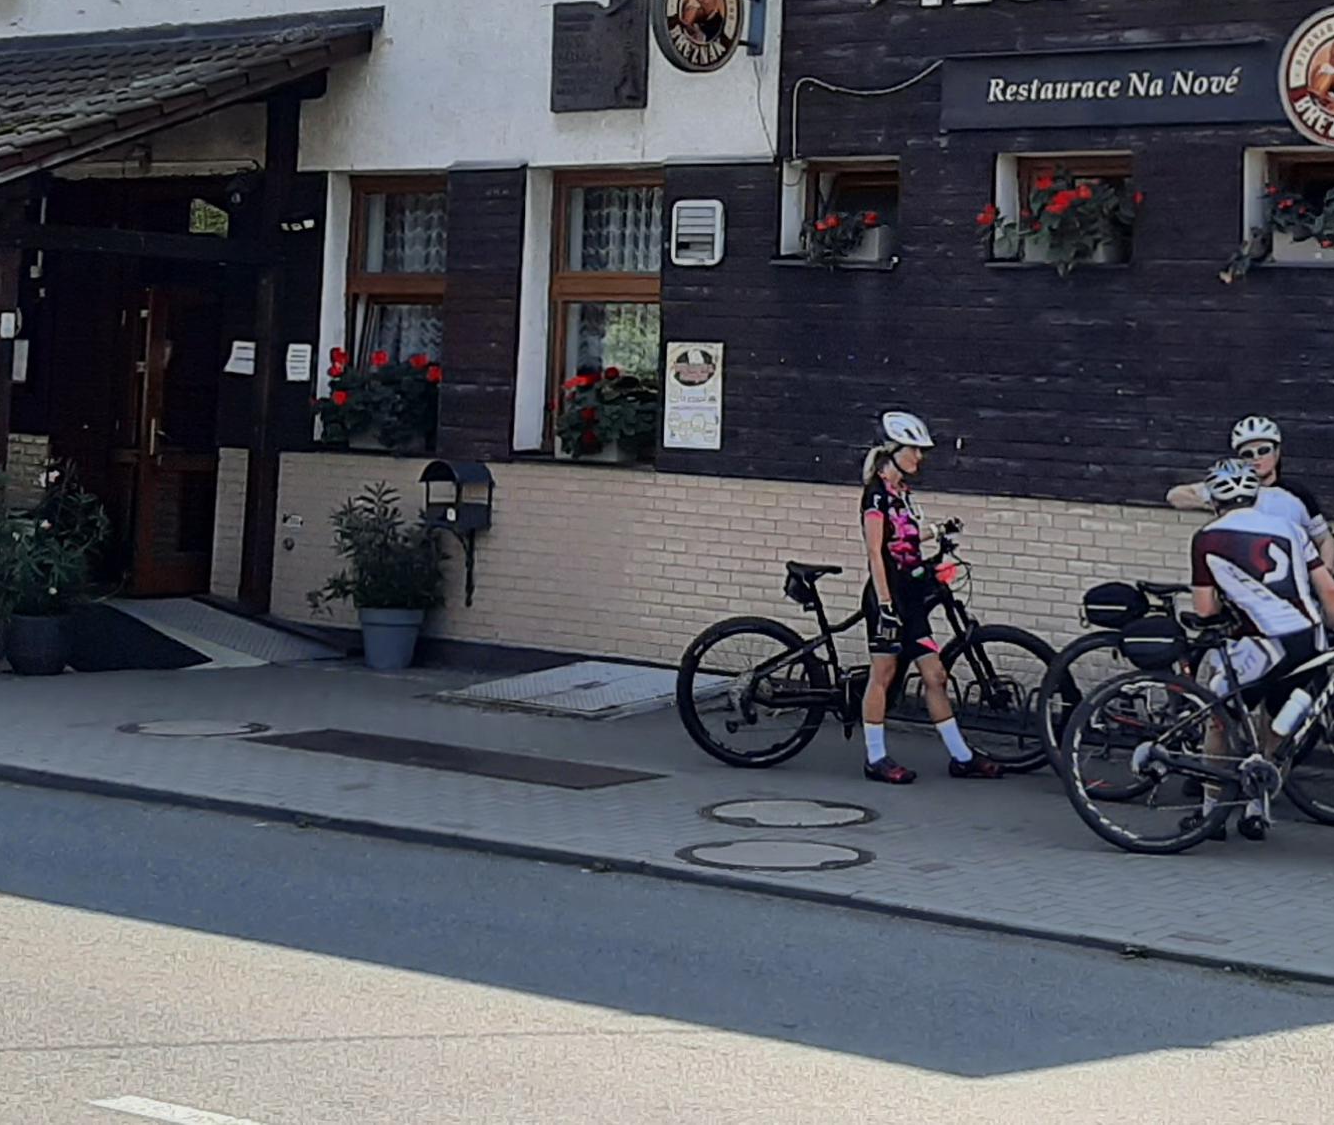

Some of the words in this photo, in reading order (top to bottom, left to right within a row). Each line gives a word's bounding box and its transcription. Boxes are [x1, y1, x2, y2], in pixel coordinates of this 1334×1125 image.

[986, 78, 1122, 103] Restaurace
[1127, 72, 1165, 97] Na
[1170, 66, 1243, 96] Nové
